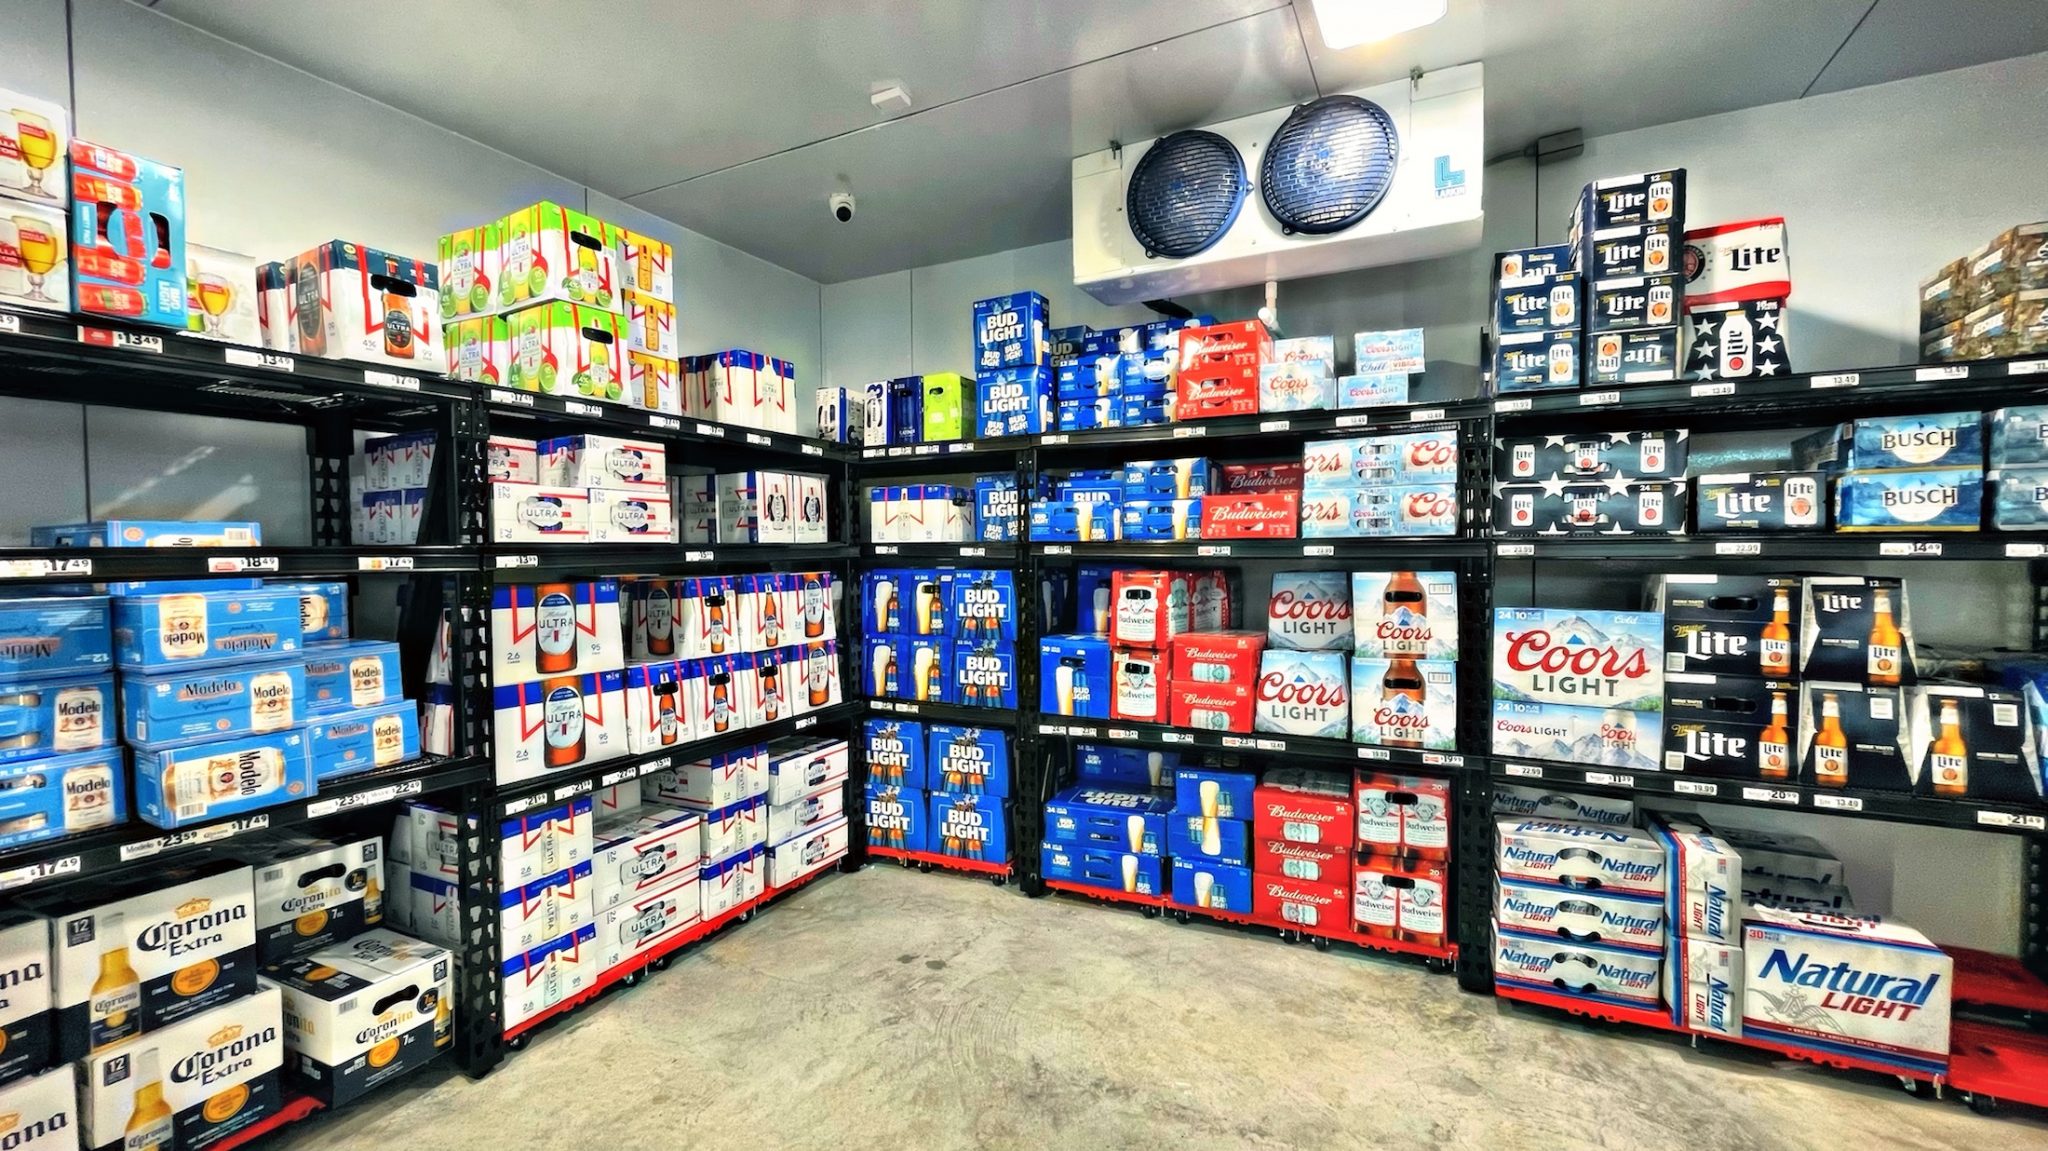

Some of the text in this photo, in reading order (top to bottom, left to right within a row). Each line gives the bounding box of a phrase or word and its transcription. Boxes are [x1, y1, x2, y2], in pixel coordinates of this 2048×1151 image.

[1651, 185, 1672, 197] Lite
[1606, 192, 1645, 213] Lite
[1647, 237, 1668, 249] Lite
[1602, 244, 1641, 265] Lite
[1730, 245, 1781, 271] Lite
[158, 282, 170, 313] LIGHT
[171, 284, 182, 311] BUD
[1552, 290, 1573, 301] Lite
[1650, 289, 1671, 301] Lite
[1509, 296, 1547, 316] Lite
[1606, 295, 1645, 317] Lite
[387, 322, 410, 332] ULTRA
[987, 312, 1018, 329] BUD
[981, 324, 1024, 343] LIGHT
[1365, 343, 1414, 354] Coors LIGHT
[1727, 330, 1748, 356] Lite
[1361, 361, 1387, 372] Chill
[1509, 352, 1546, 372] Lite
[1270, 376, 1309, 390] Coors
[1834, 376, 1857, 384] 13.49
[989, 384, 1023, 399] BUD
[1186, 384, 1245, 401] Budweiser
[1274, 387, 1304, 398] LIGHT
[1375, 386, 1398, 395] LIGHT
[984, 397, 1030, 413] LIGHT
[1883, 431, 1955, 450] BUSCH
[1644, 444, 1663, 455] Lite
[613, 459, 640, 469] ULTRA
[1755, 479, 1767, 487] 24
[1787, 482, 1814, 497] Lite
[1714, 492, 1771, 519] Lite
[1884, 489, 1956, 507] BUSCH
[526, 508, 558, 518] ULTRA
[618, 511, 645, 521] ULTRA
[965, 589, 1000, 604] BUD
[1822, 594, 1862, 613] Lite
[958, 603, 1007, 618] LIGHT
[1268, 590, 1353, 620] Coors
[539, 616, 574, 629] ULTRA
[1498, 611, 1526, 620] 24 10
[1614, 615, 1637, 624] Cold
[1283, 622, 1337, 635] LIGHT
[1376, 620, 1433, 641] Coors
[1185, 647, 1238, 660] Budweiser
[1383, 640, 1427, 652] LIGHT
[1505, 630, 1651, 678] Coors
[1684, 631, 1748, 661] Lite
[1873, 647, 1897, 658] Lite
[507, 652, 521, 660] 2.6
[966, 656, 1001, 670] BUD
[352, 667, 382, 679] Modelo
[959, 670, 1008, 686] LIGHT
[185, 680, 236, 697] Modelo
[253, 685, 291, 700] Modelo
[1257, 671, 1346, 707] Coors
[1532, 674, 1619, 697] LIGHT
[1766, 681, 1777, 689] 20
[59, 698, 101, 716] Modelo
[1183, 694, 1237, 706] Budweiser
[1496, 703, 1510, 712] 24
[547, 711, 582, 724] ULTRA
[1271, 705, 1328, 722] LIGHT
[1373, 708, 1430, 728] Coors
[1380, 726, 1424, 739] LIGHT
[1497, 719, 1567, 737] Coors LIGHT
[871, 738, 903, 753] BUD
[949, 744, 984, 760] BUD
[1683, 730, 1746, 762] Lite
[1763, 743, 1785, 754] Lite
[1820, 748, 1843, 759] Lite
[516, 750, 529, 758] 2.6
[866, 750, 909, 767] LIGHT
[1937, 756, 1961, 768] Lite
[239, 749, 262, 796] Modelo
[942, 758, 991, 775] LIGHT
[67, 777, 110, 794] Modelo
[871, 800, 904, 816] BUD
[1494, 792, 1540, 810] Natural
[948, 809, 982, 826] BUD
[1267, 803, 1334, 823] Budweiser
[1577, 805, 1631, 825] Natural
[865, 813, 910, 831] LIGHT
[1405, 823, 1446, 833] Budweiser
[941, 822, 989, 841] LIGHT
[1268, 841, 1333, 861] Budweiser
[1503, 846, 1559, 864] Natural
[521, 866, 532, 874] 2.6
[632, 856, 664, 874] ULTRA
[1524, 861, 1555, 870] LIGHT
[1602, 859, 1662, 876] Natural
[1623, 872, 1656, 882] LIGHT
[1266, 883, 1332, 904] Budweiser
[1401, 907, 1442, 918] Budweiser
[1503, 898, 1558, 917] Natural
[1704, 881, 1726, 940] Natural
[631, 913, 664, 932] ULTRA
[1523, 912, 1554, 923] LIGHT
[1601, 911, 1661, 930] Natural
[1693, 902, 1703, 930] LIGHT
[72, 918, 90, 934] 12
[136, 903, 247, 952] Corona
[1622, 927, 1655, 937] LIGHT
[1749, 929, 1764, 940] 30
[169, 932, 223, 957] Extra
[1499, 948, 1554, 967] Natural
[1519, 964, 1551, 974] LIGHT
[1597, 963, 1656, 982] Natural
[1618, 979, 1650, 989] LIGHT
[1758, 949, 1941, 1006] Natural
[523, 1001, 534, 1011] 2.6
[1695, 993, 1706, 1023] LIGHT
[1706, 973, 1728, 1032] Natural
[1821, 992, 1922, 1023] LIGHT
[170, 1026, 277, 1083] Corona
[109, 1059, 125, 1072] 12
[200, 1056, 252, 1086] Extra
